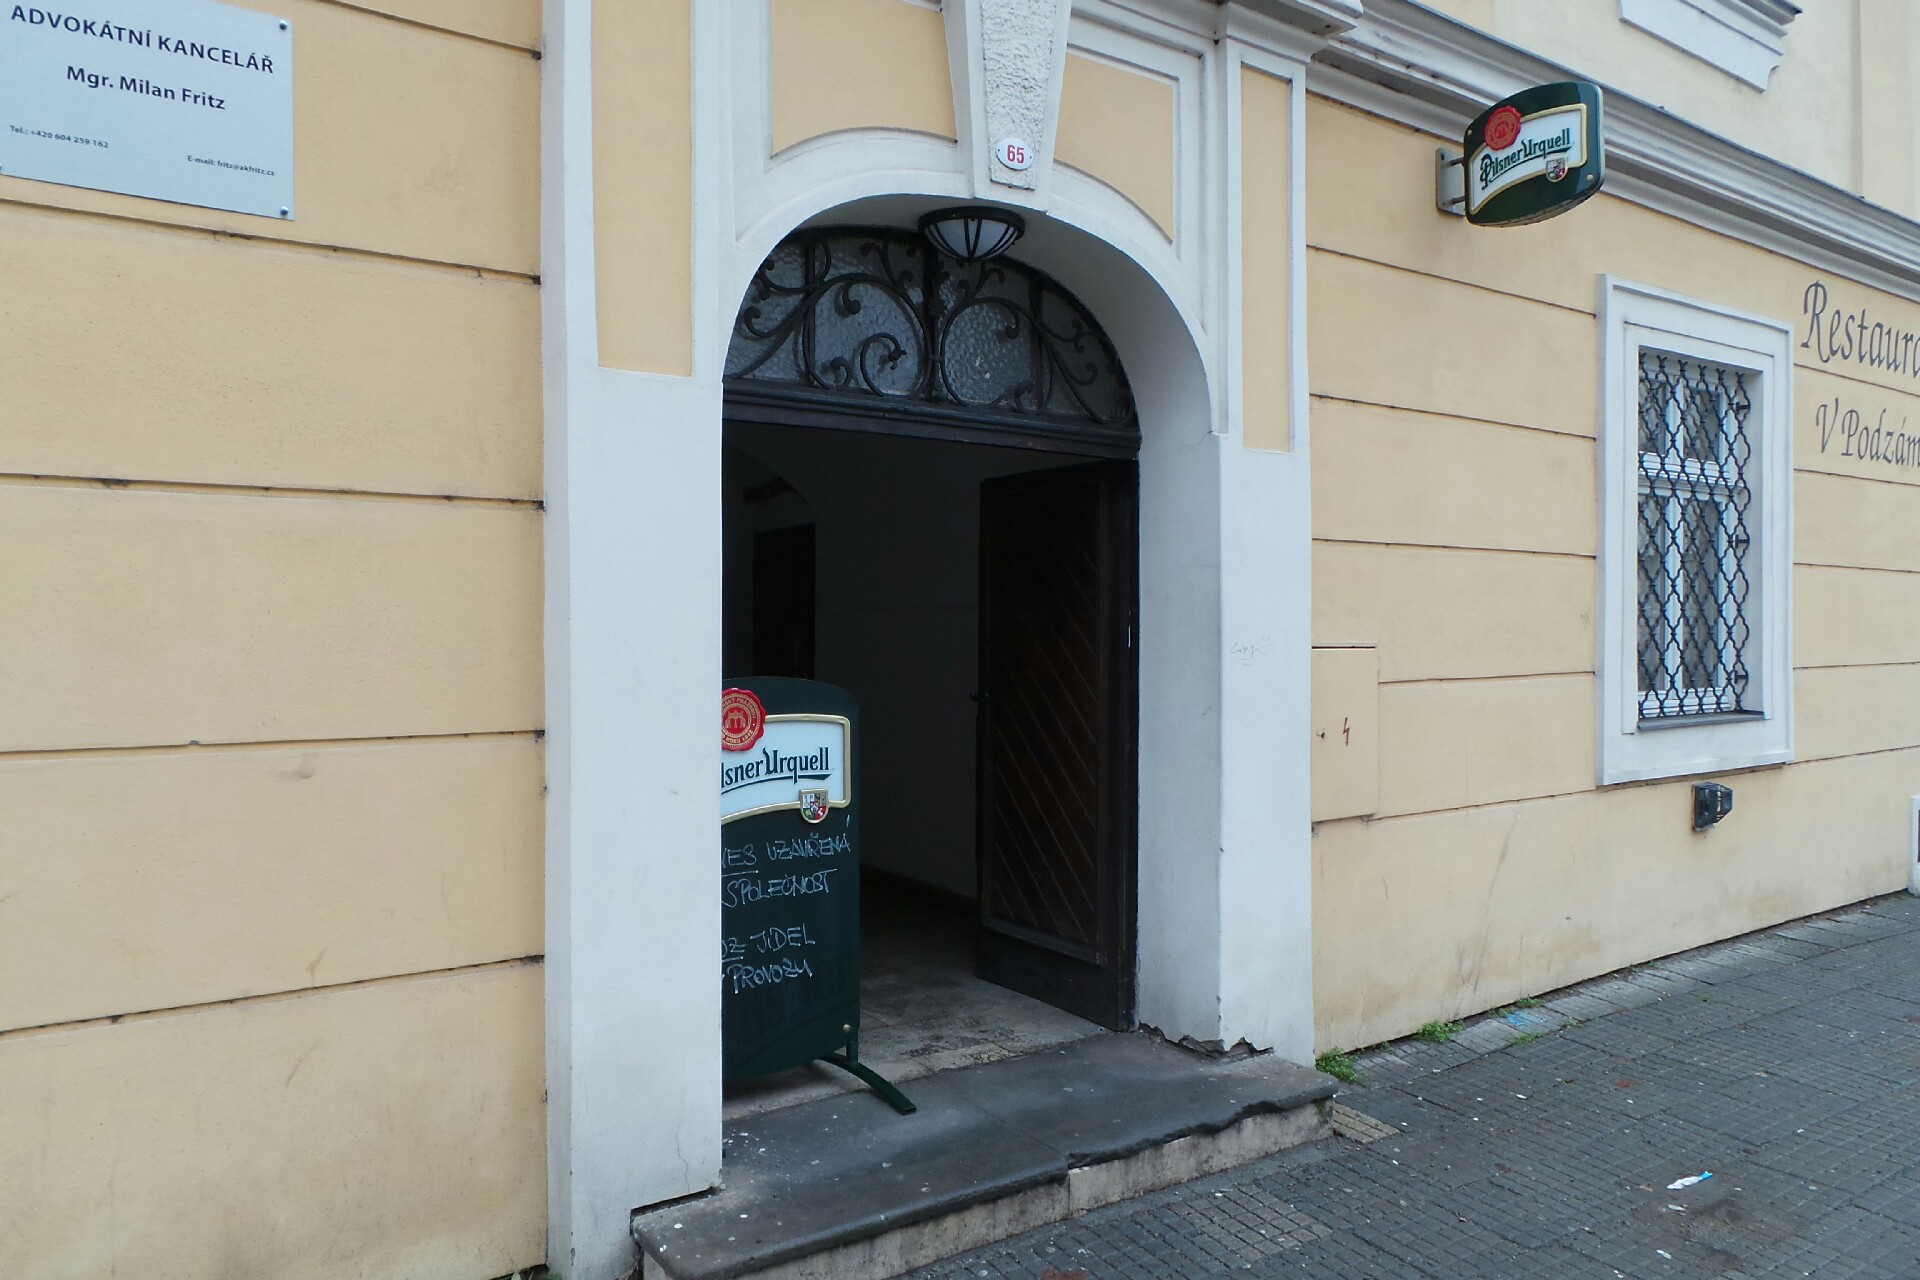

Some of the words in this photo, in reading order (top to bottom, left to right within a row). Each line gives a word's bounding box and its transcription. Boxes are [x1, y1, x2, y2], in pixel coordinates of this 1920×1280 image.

[11, 4, 152, 48] ADVOKÁTNÍ
[158, 35, 274, 74] KANCELÁŘ
[66, 65, 114, 89] Mgr.
[119, 75, 175, 100] Milan
[181, 88, 226, 110] Fritz
[30, 129, 54, 139] +420
[54, 133, 71, 142] 604
[73, 136, 90, 145] 259
[92, 139, 109, 149] 162
[187, 154, 216, 166] E-mail:
[1006, 144, 1025, 164] 65
[1480, 148, 1523, 190] Pilsner
[1520, 127, 1570, 160] Urquell
[1815, 397, 1839, 454] V
[762, 746, 829, 785] Urquell
